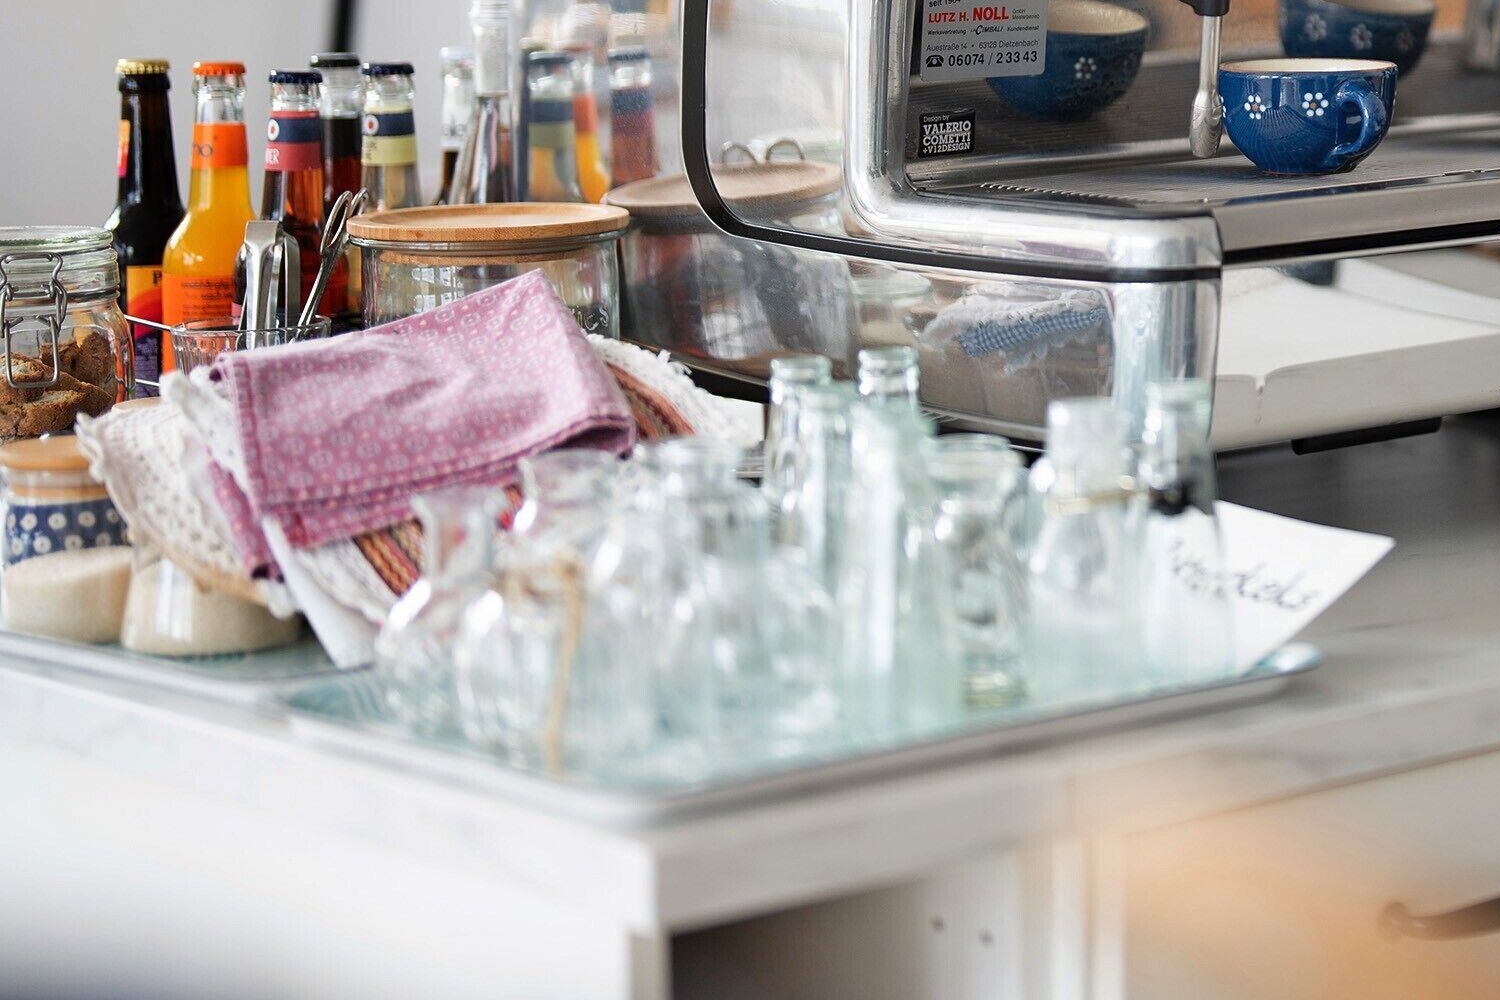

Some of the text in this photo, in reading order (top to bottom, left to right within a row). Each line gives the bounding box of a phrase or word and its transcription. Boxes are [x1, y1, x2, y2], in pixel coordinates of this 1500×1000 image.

[928, 0, 942, 7] seit
[928, 6, 1009, 23] LUTZ H. NOLL
[999, 39, 1039, 48] Dietzenbach
[948, 53, 985, 67] 06074
[923, 114, 942, 122] Design
[923, 120, 971, 136] VALERIO
[922, 131, 971, 146] COMETTI
